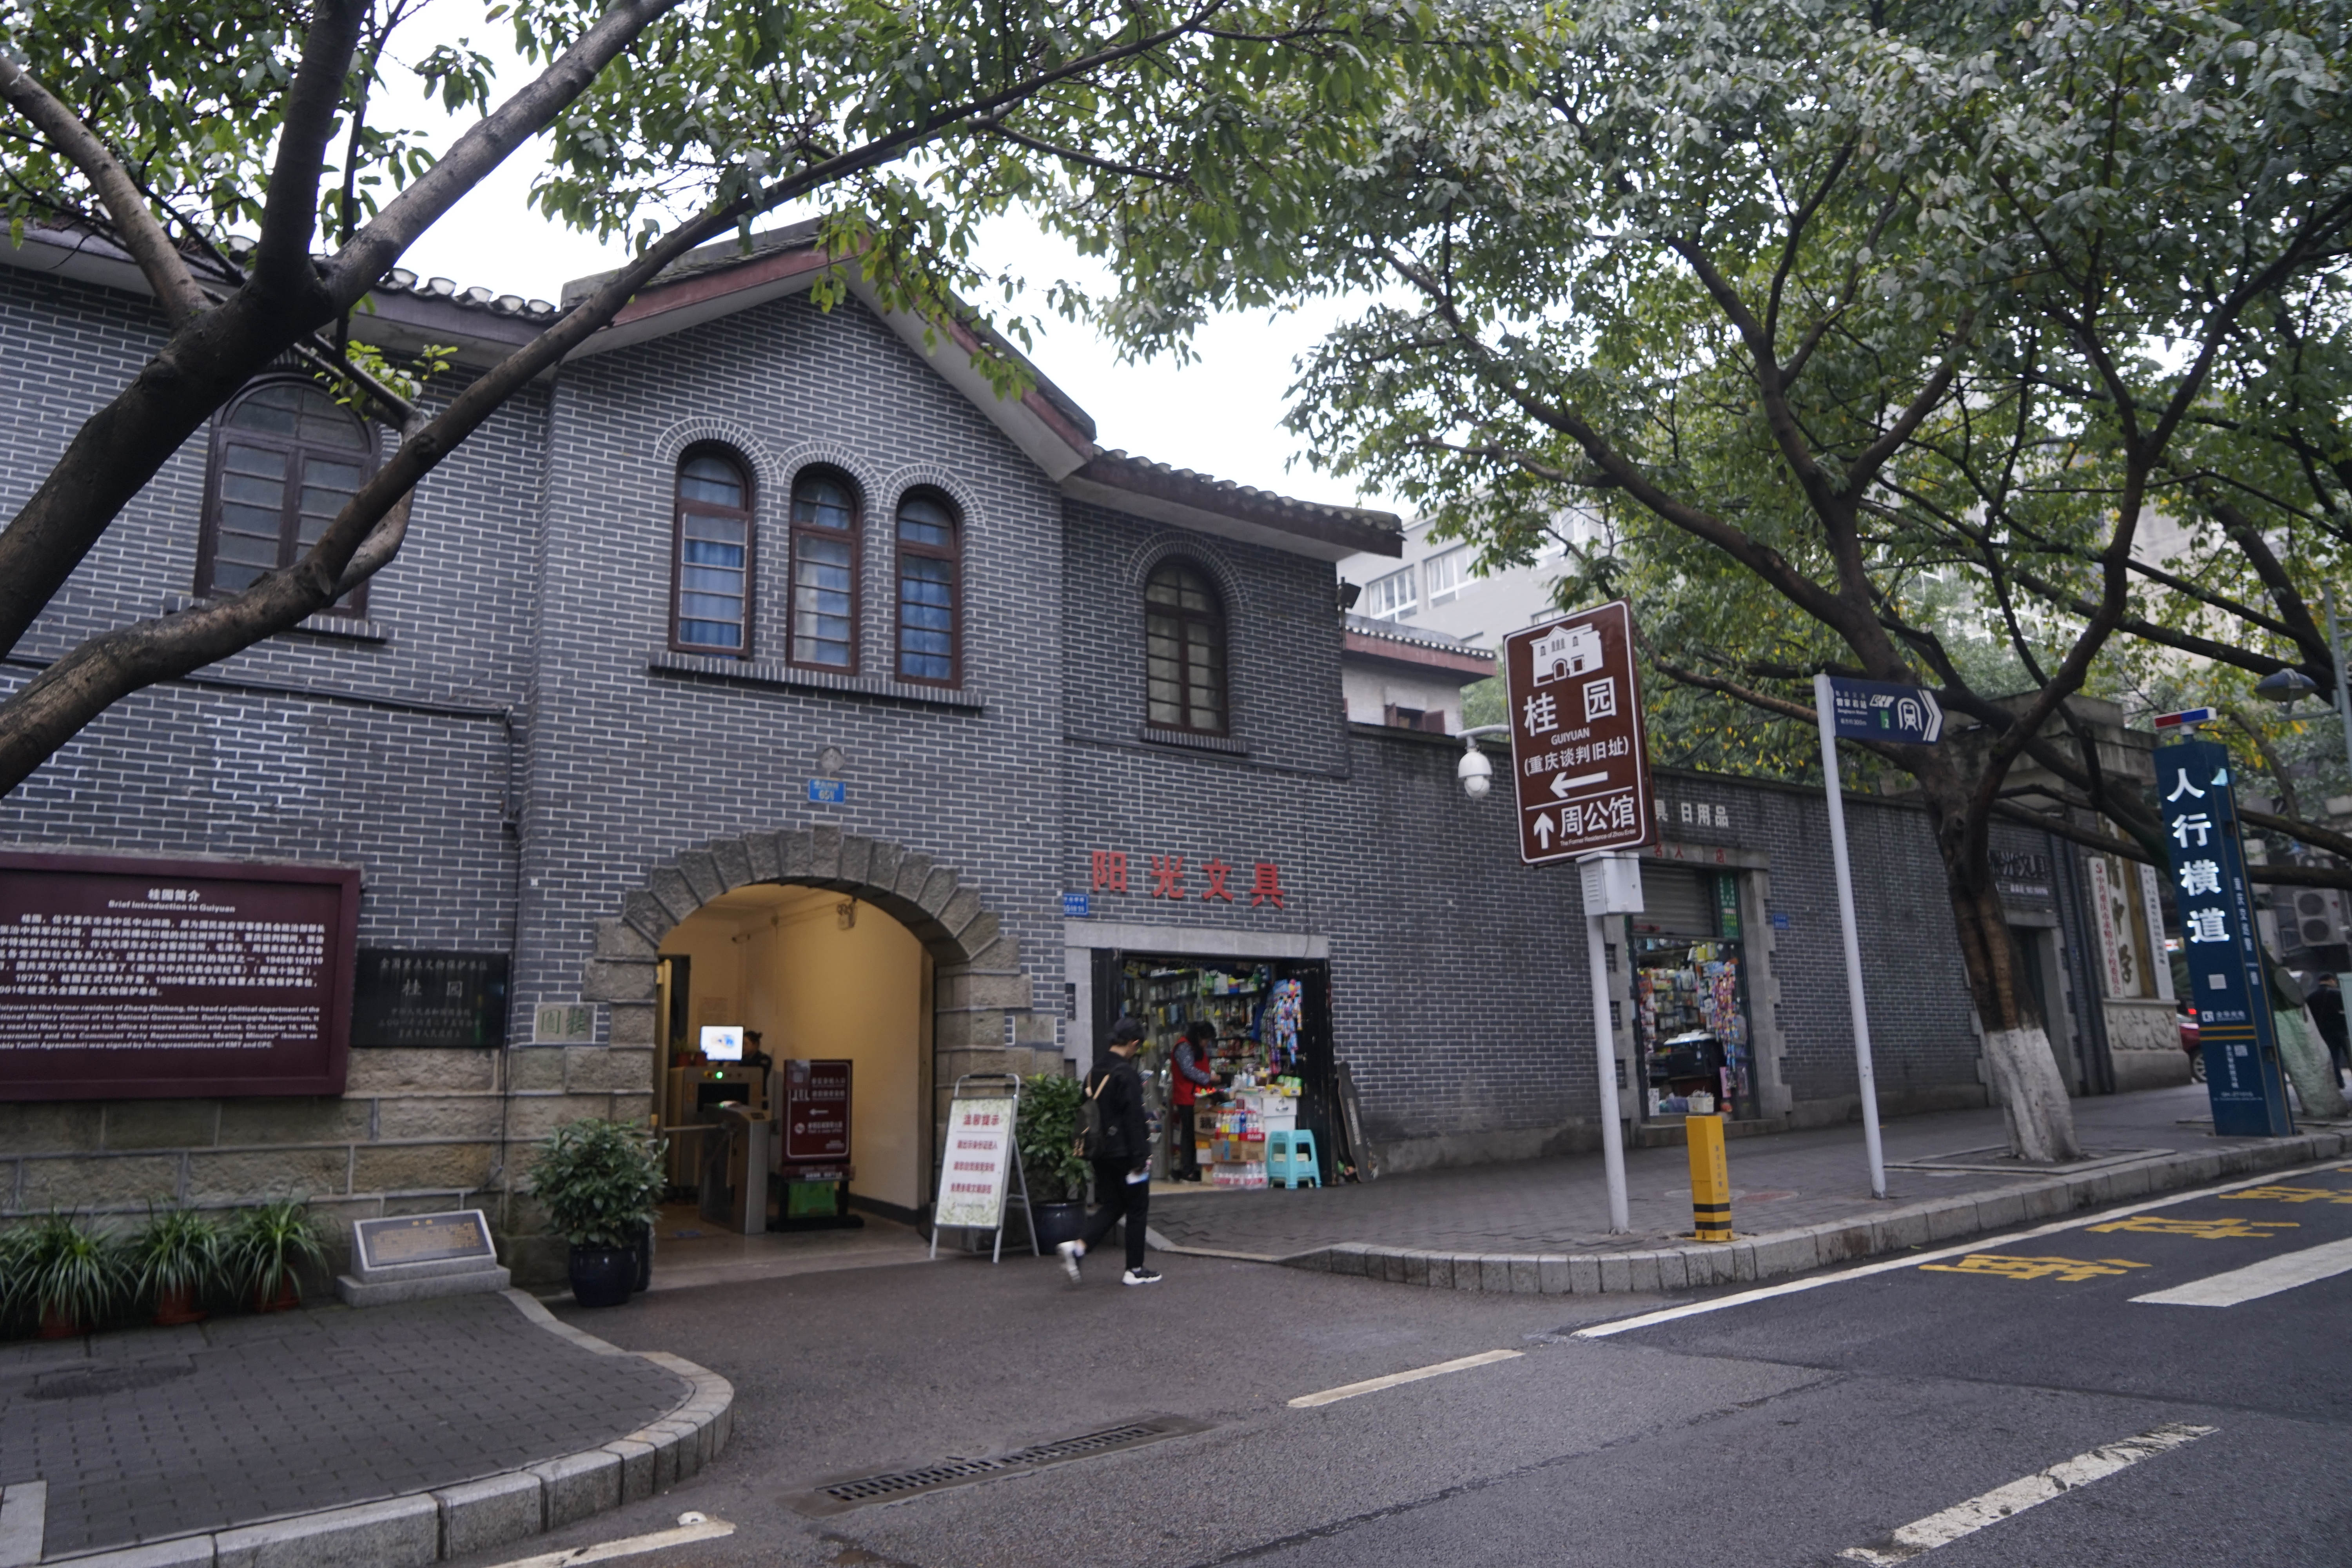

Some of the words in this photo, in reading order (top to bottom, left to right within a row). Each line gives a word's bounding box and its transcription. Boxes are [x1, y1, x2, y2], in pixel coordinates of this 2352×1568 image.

[1523, 677, 1617, 737] 桂园
[1551, 727, 1590, 745] GUIYUAN
[1524, 736, 1630, 777] (重庆谈判旧址)
[1560, 795, 1635, 838] 周公馆
[1681, 802, 1729, 828] 日用品
[2167, 768, 2230, 944] 人行横道
[148, 888, 200, 902] 桂园简介
[1092, 850, 1284, 909] 阳光文具
[108, 899, 131, 909] Brief
[131, 901, 187, 911] Introduction
[189, 903, 198, 911] to
[199, 903, 236, 914] Guiyuan
[401, 978, 463, 998] 桂园
